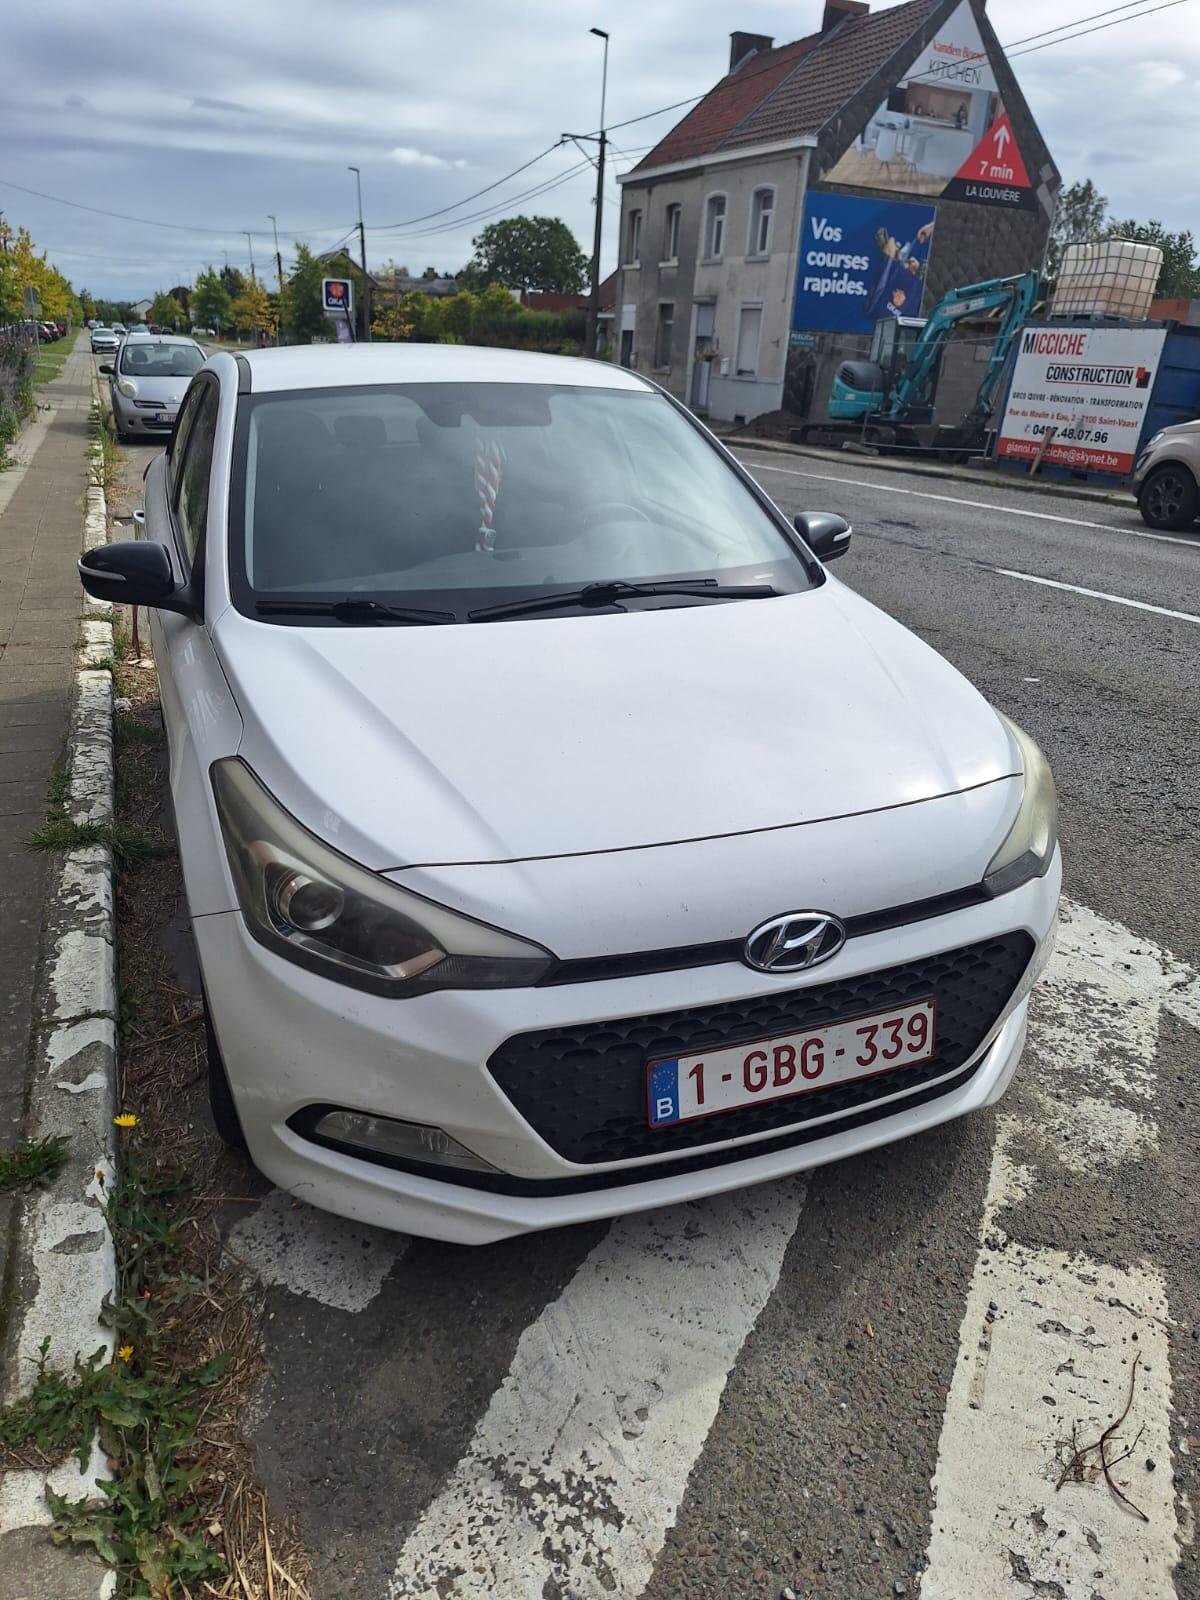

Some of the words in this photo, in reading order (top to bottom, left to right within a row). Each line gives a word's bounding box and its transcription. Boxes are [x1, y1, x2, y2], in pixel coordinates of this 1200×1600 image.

[929, 59, 983, 85] KITCHEN
[980, 160, 989, 176] 7
[990, 163, 1014, 180] min
[965, 185, 977, 197] LA
[811, 216, 842, 242] Vos
[806, 251, 869, 271] courses
[803, 271, 868, 297] rapides.
[1022, 333, 1087, 355] MICCICHE
[1046, 366, 1134, 385] CONSTRUCTION
[1090, 397, 1144, 410] TRANSFORMATION
[656, 1096, 675, 1119] B
